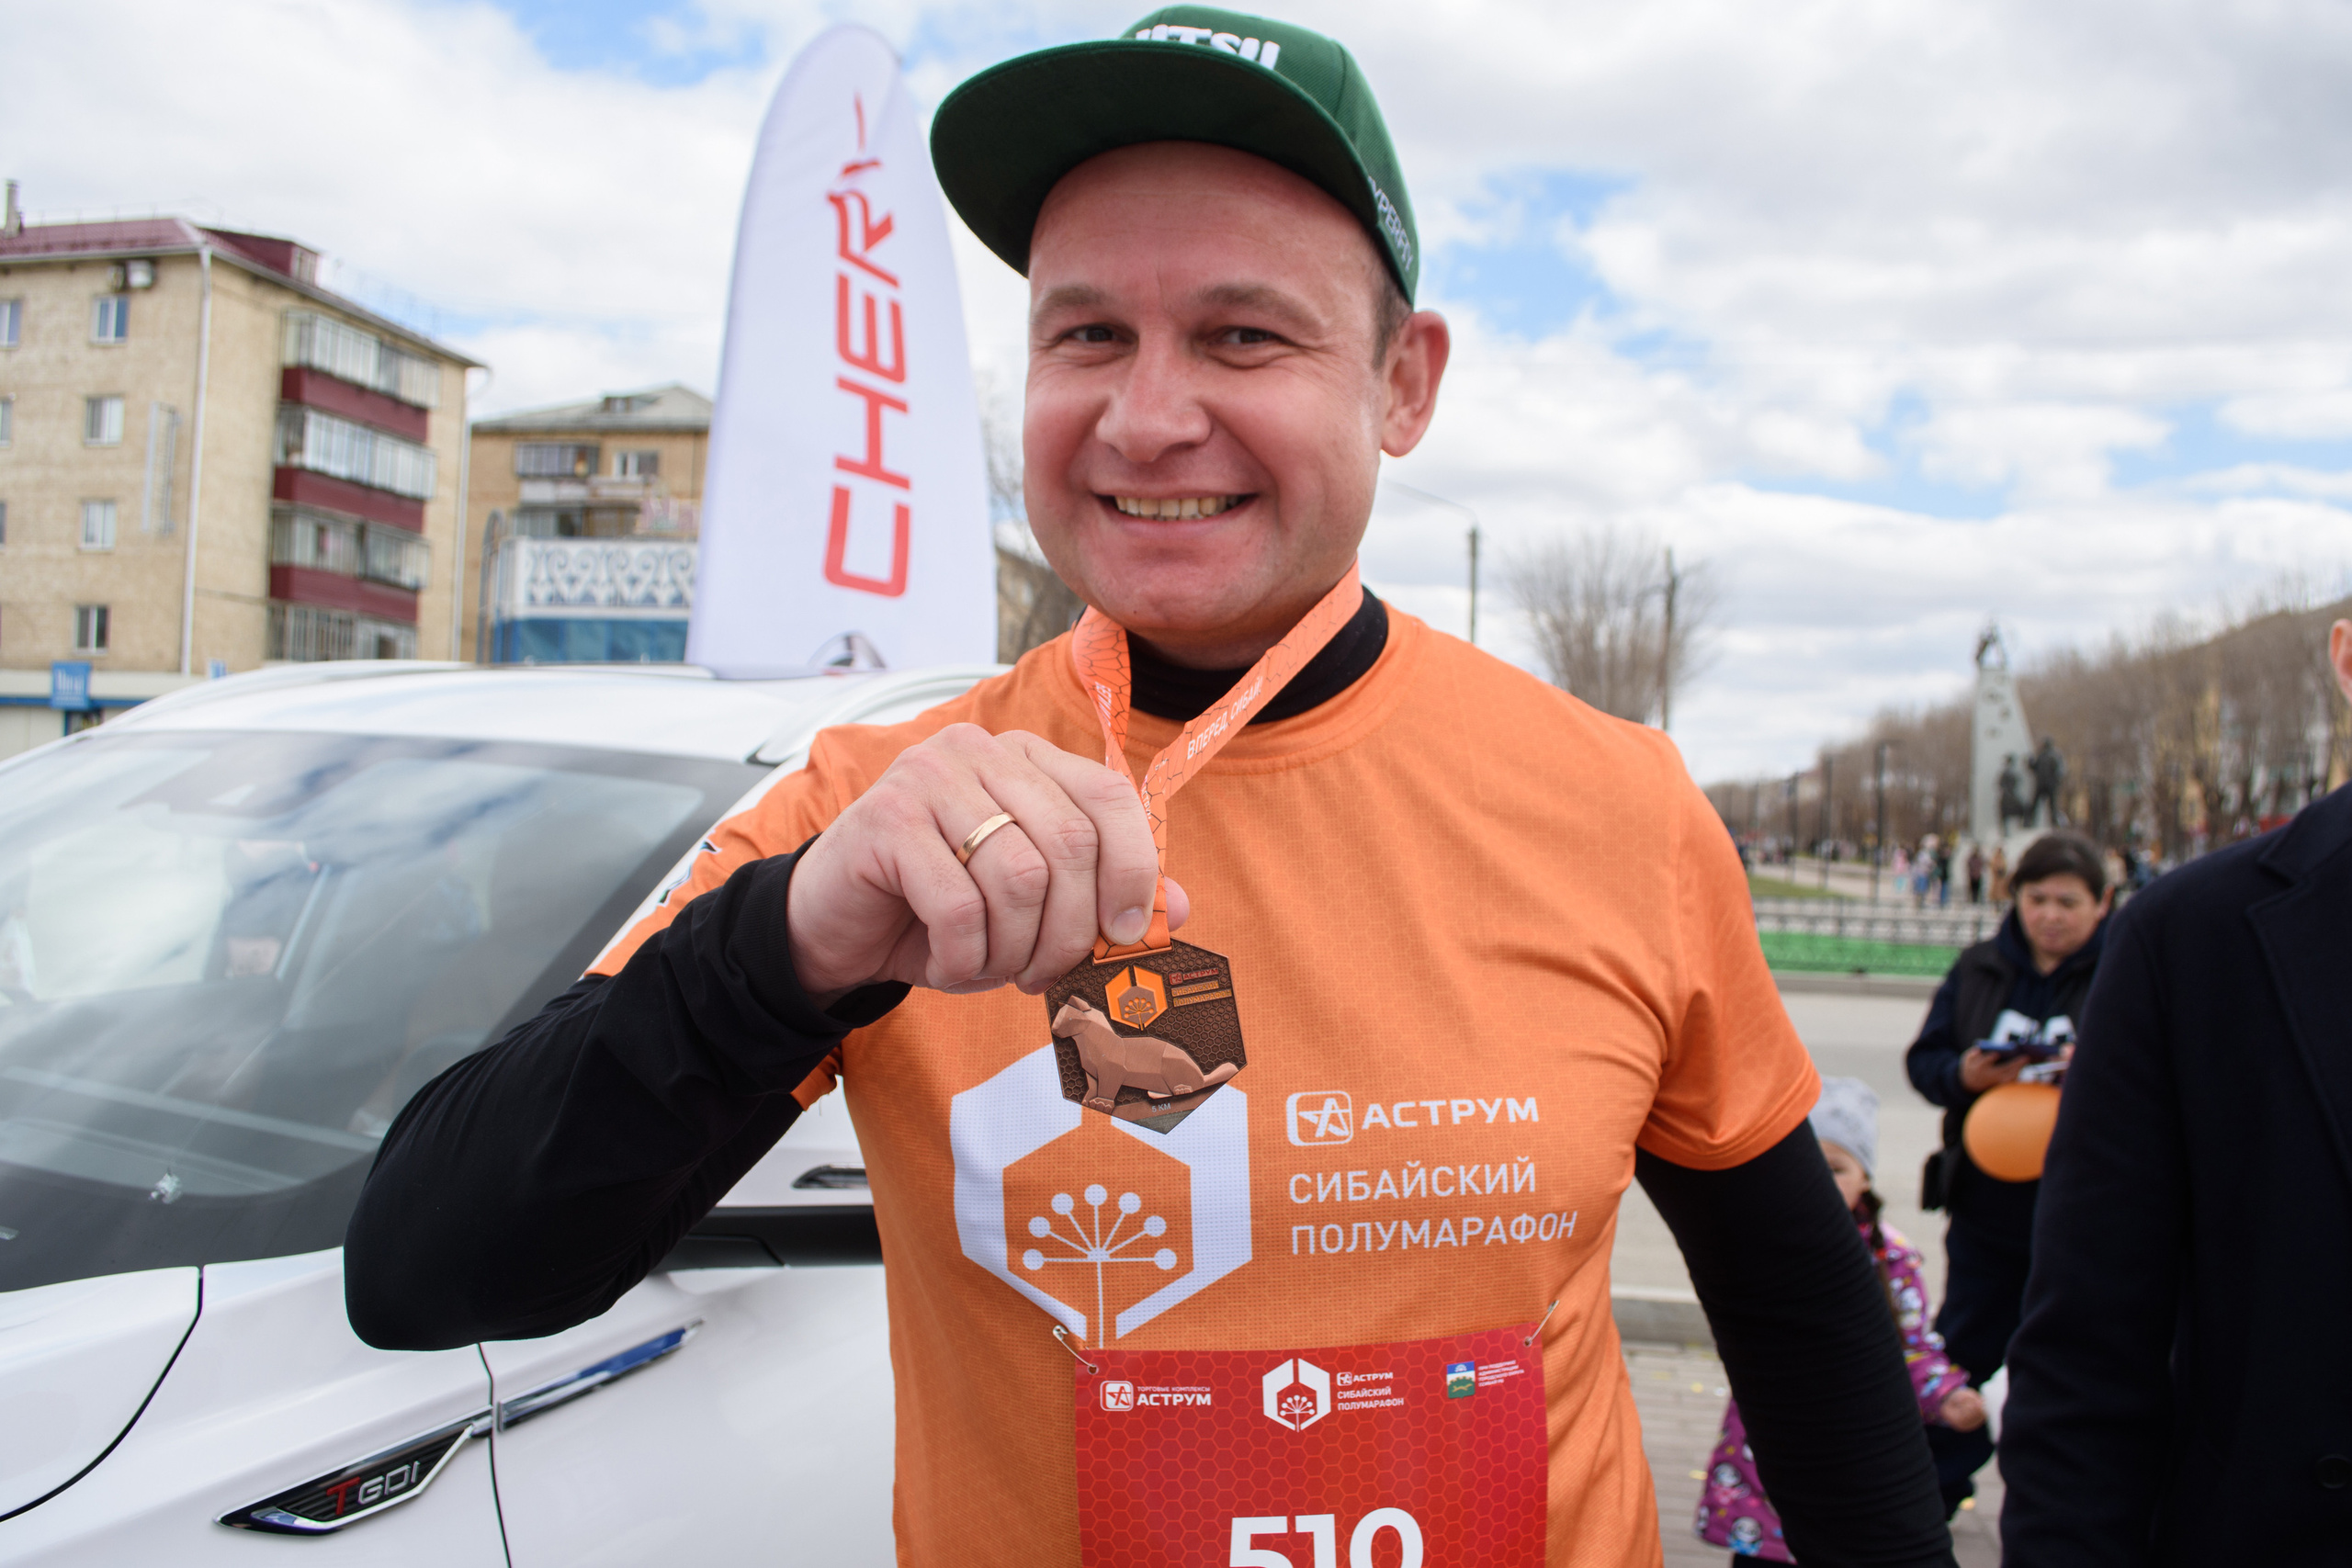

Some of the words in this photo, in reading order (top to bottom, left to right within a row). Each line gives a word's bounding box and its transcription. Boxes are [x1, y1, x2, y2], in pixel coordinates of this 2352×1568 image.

[1183, 968, 1219, 980] АСТРУМ
[1173, 989, 1232, 1007] ПОЛУМАРАФОН
[1151, 1105, 1158, 1113] 5
[1362, 1097, 1539, 1130] АСТРУМ
[1289, 1156, 1535, 1203] СИБАЙСКИЙ
[1292, 1211, 1577, 1255] ПОЛУМАРАФОН
[1352, 1371, 1394, 1382] АСТРУМ
[1136, 1393, 1212, 1406] АСТРУМ
[1337, 1386, 1391, 1399] СИБАЙСКИЙ
[1338, 1397, 1404, 1411] ПОЛУМАРАФОН
[1229, 1507, 1424, 1568] 510
